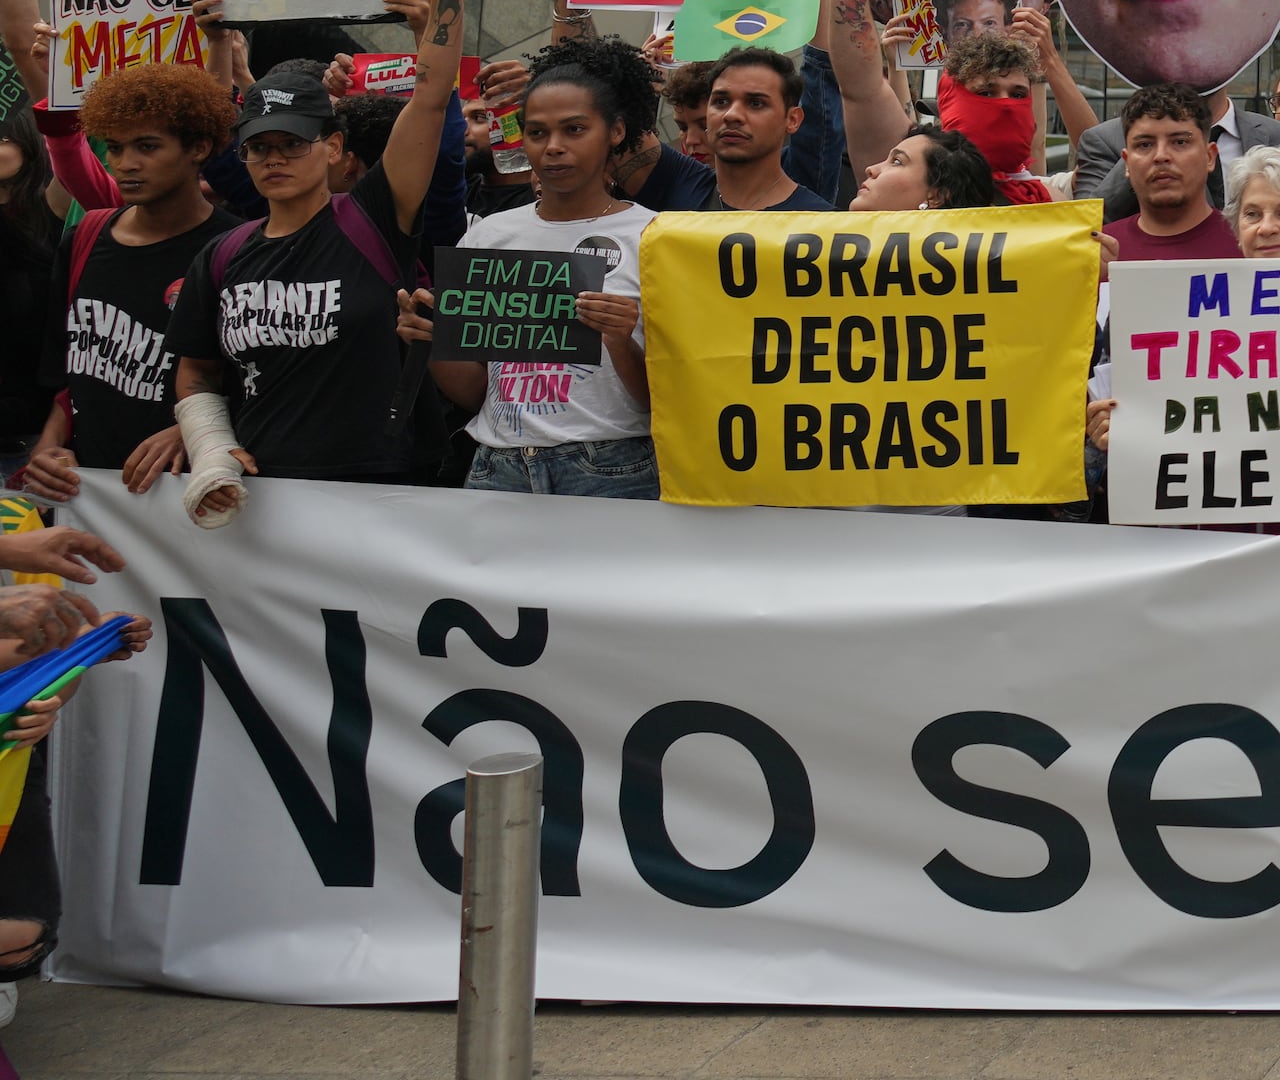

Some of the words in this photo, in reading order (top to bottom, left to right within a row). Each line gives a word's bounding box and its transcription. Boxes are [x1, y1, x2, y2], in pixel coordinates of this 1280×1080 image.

[73, 18, 205, 88] META
[467, 258, 522, 286] FIM
[528, 260, 571, 288] DA
[719, 233, 758, 298] O
[783, 232, 1018, 297] BRASIL
[221, 280, 342, 316] LEVANTE
[225, 309, 309, 331] POPULAR
[439, 289, 580, 320] CENSUR
[68, 297, 175, 370] LEVANTE
[460, 322, 577, 351] DIGITAL
[752, 313, 986, 384] DECIDE
[1131, 330, 1278, 380] TIRA
[718, 404, 758, 472] O
[784, 399, 1019, 472] BRASIL
[1165, 396, 1221, 434] DA
[139, 596, 816, 909] Não
